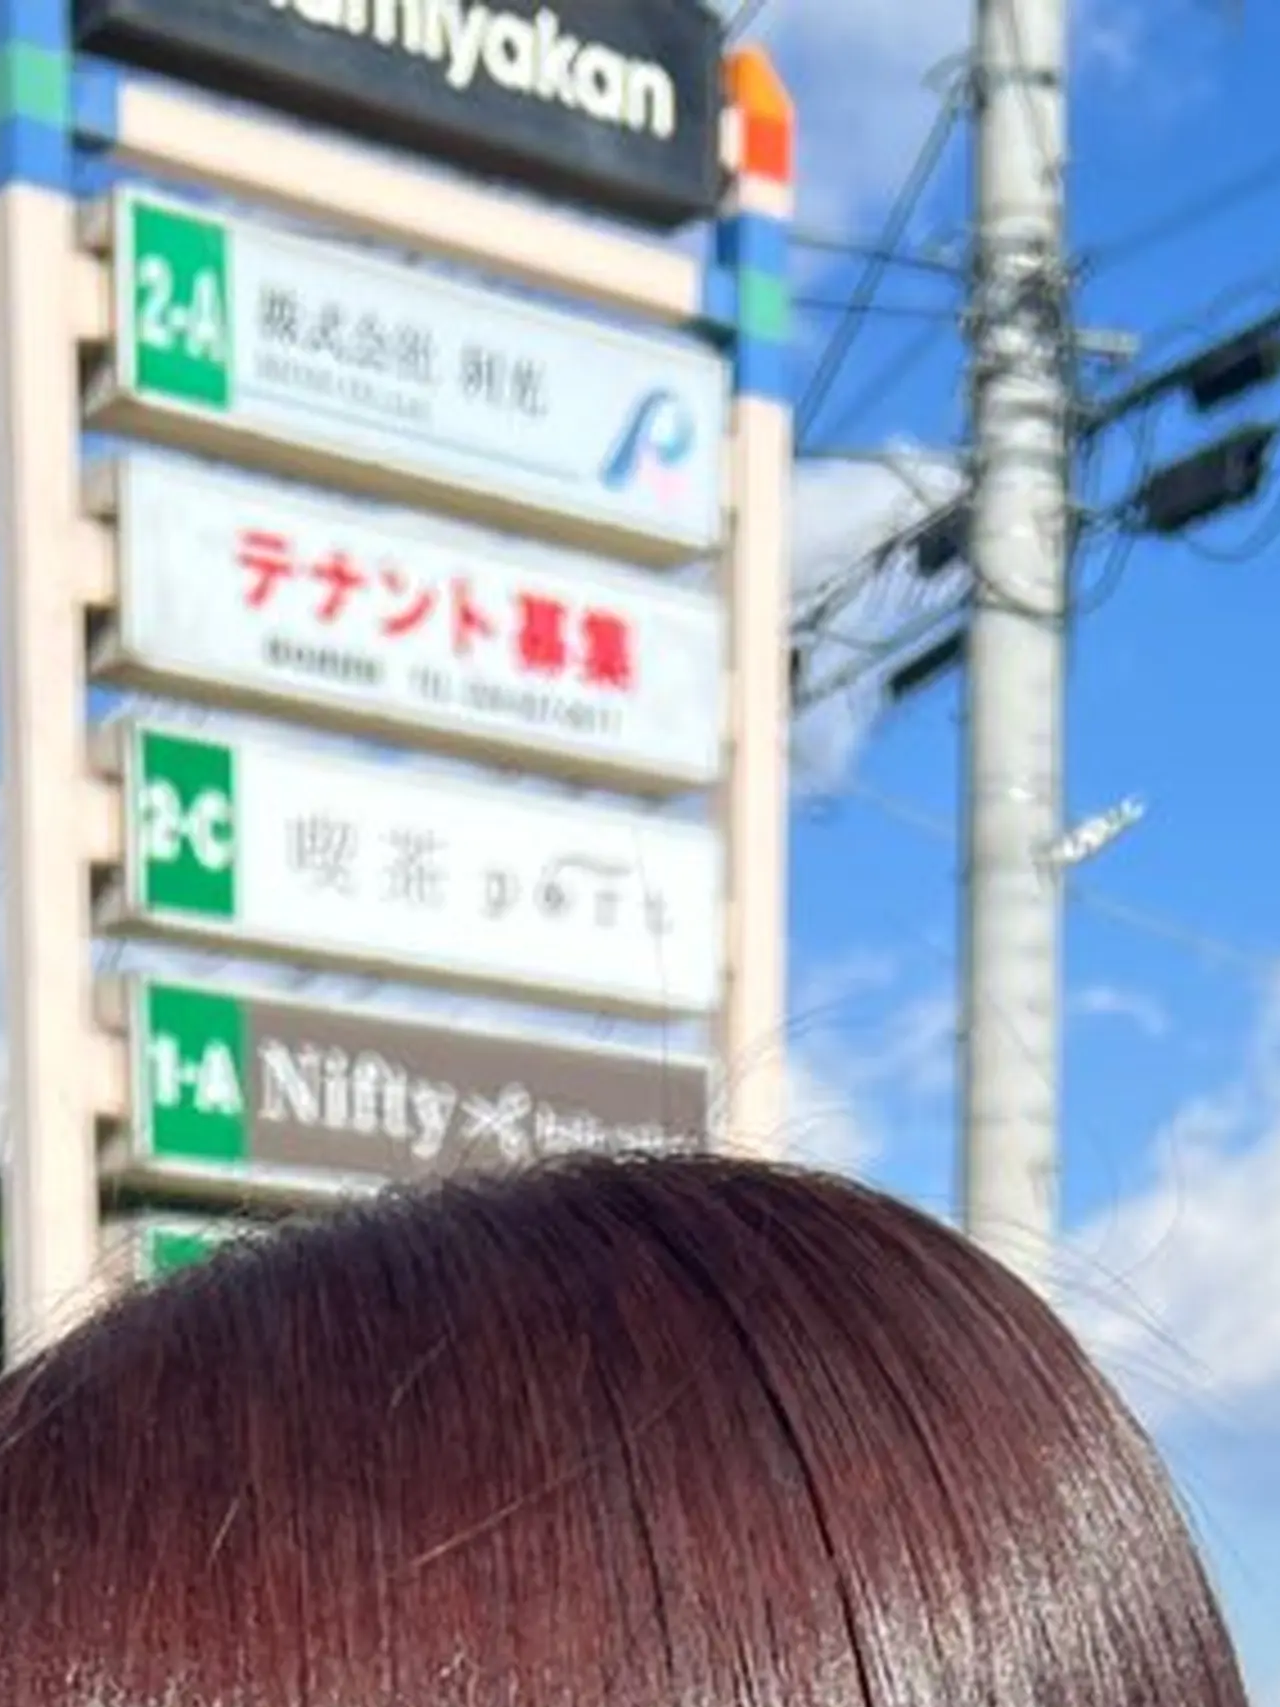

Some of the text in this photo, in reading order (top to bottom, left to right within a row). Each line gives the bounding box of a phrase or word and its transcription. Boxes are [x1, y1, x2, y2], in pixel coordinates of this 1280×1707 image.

[270, 0, 676, 140] miyakan
[136, 255, 230, 362] 2-A
[235, 529, 638, 692] テナント募集
[138, 778, 234, 872] 2-C
[147, 1030, 244, 1117] 1-A
[256, 1040, 458, 1160] Nifty
